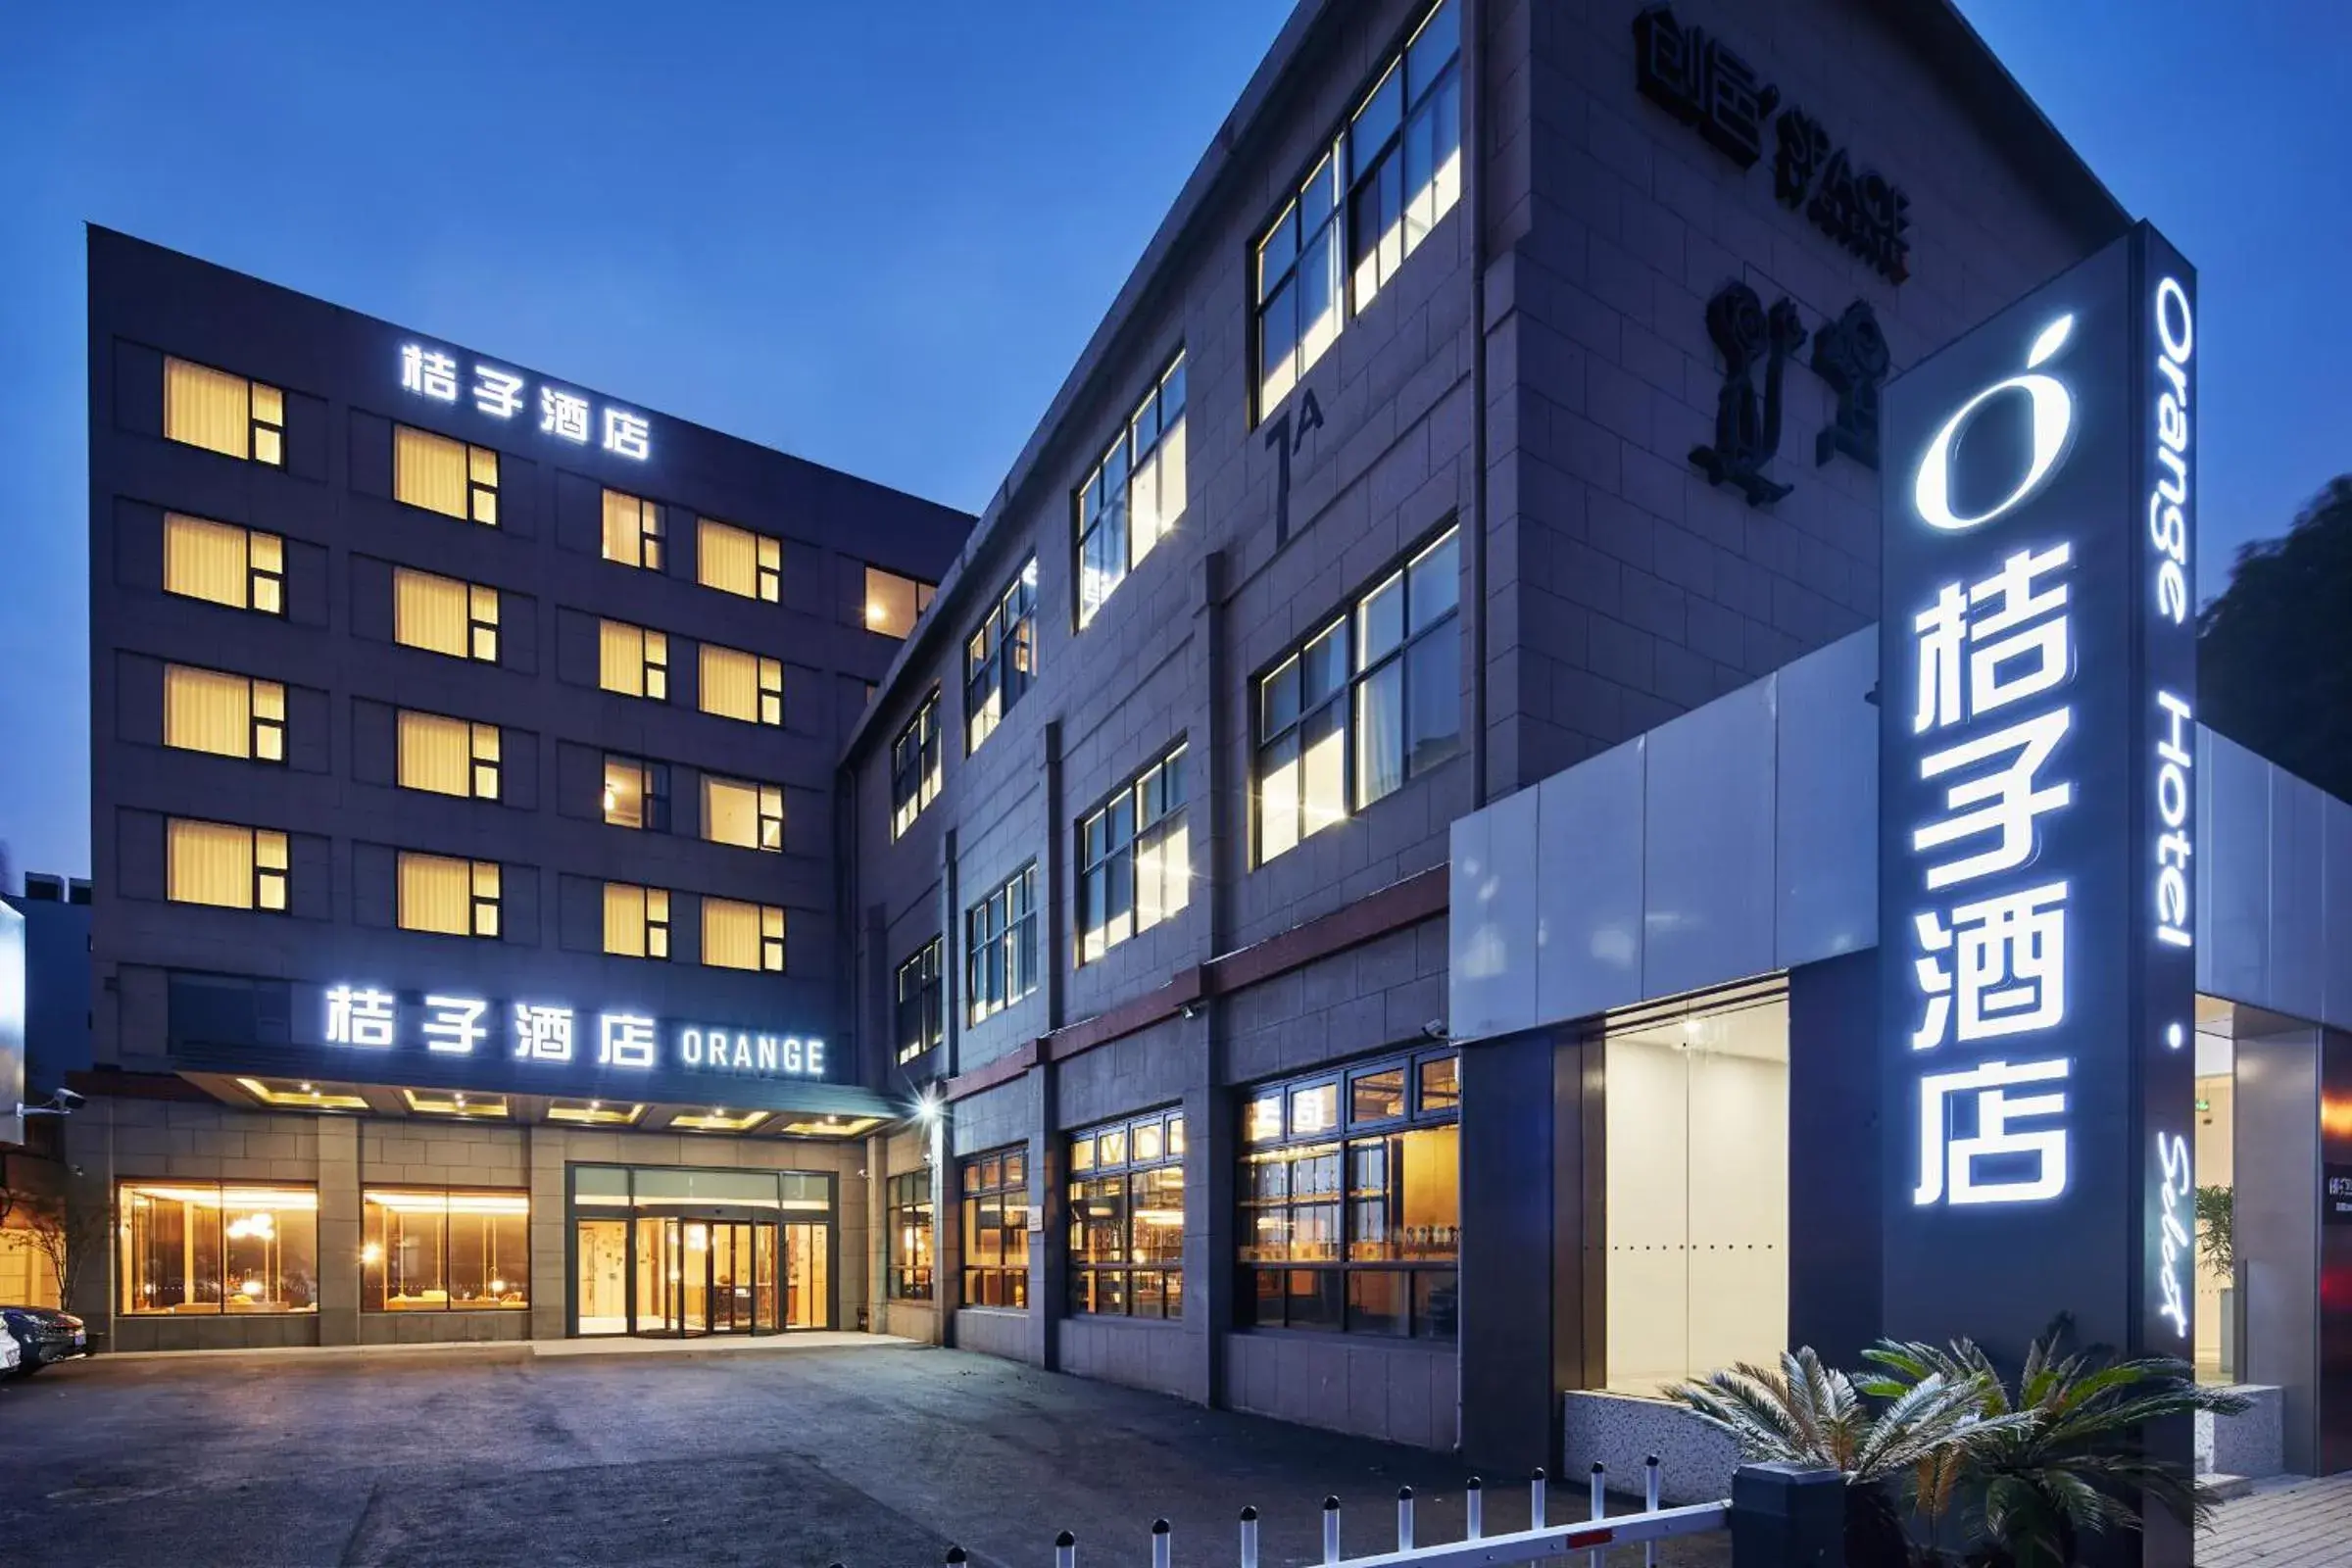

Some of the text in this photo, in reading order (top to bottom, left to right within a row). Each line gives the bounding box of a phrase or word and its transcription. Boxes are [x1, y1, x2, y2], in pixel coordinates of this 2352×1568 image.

[402, 345, 649, 460] 桔子酒店
[2151, 277, 2192, 1338] Orange Hotel Select
[1913, 542, 2070, 1205] 桔子酒店
[325, 985, 655, 1068] 桔子酒店
[682, 1029, 824, 1074] ORANGE
